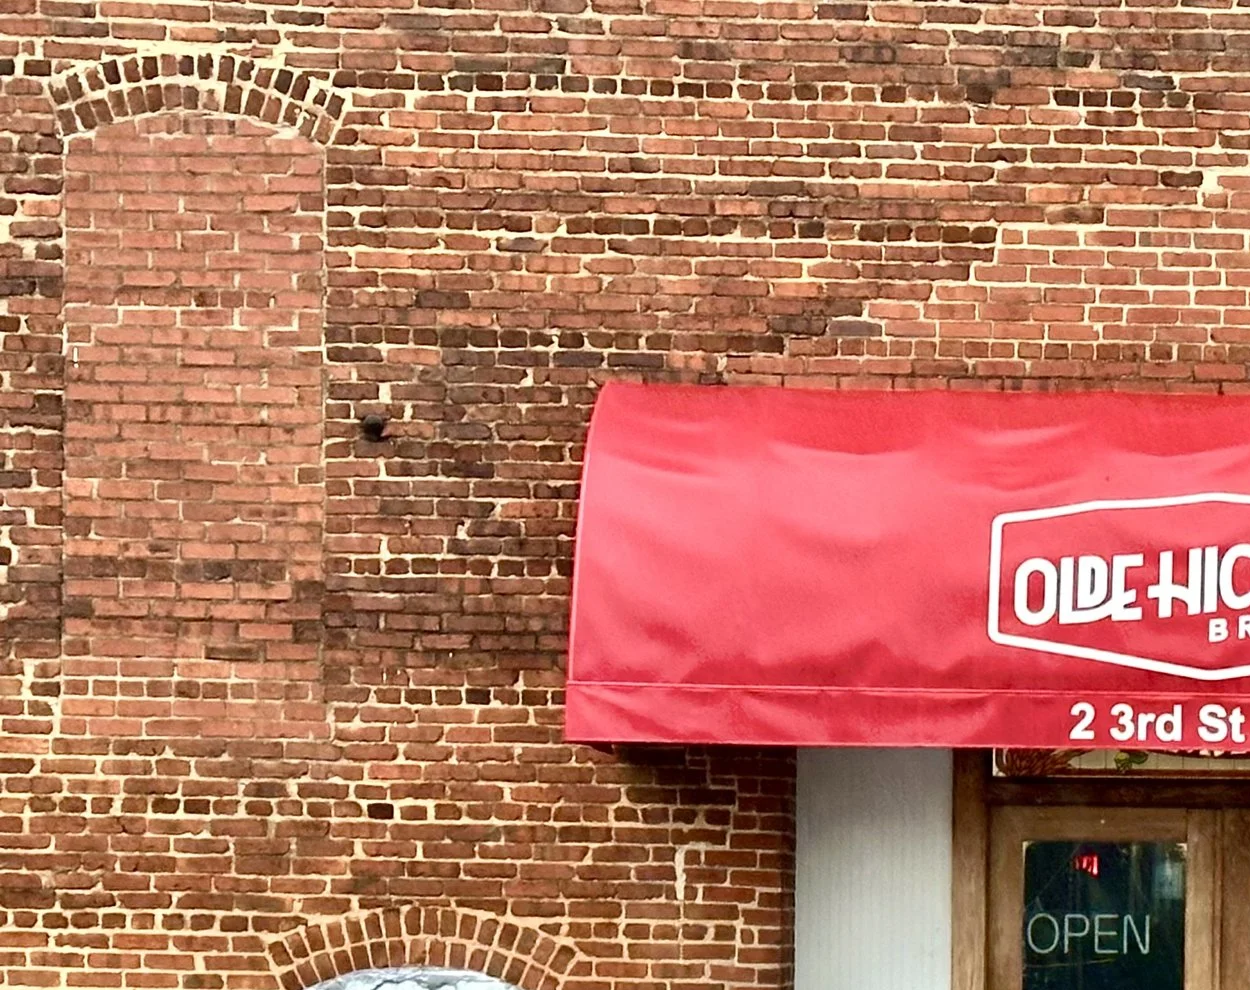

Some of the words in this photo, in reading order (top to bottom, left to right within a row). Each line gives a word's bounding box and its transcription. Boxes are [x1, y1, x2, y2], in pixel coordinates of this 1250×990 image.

[1013, 552, 1144, 626] OLDE
[1068, 702, 1096, 741] 2
[1109, 704, 1183, 742] 3rd
[1197, 704, 1246, 744] St
[1027, 912, 1150, 955] OPEN
